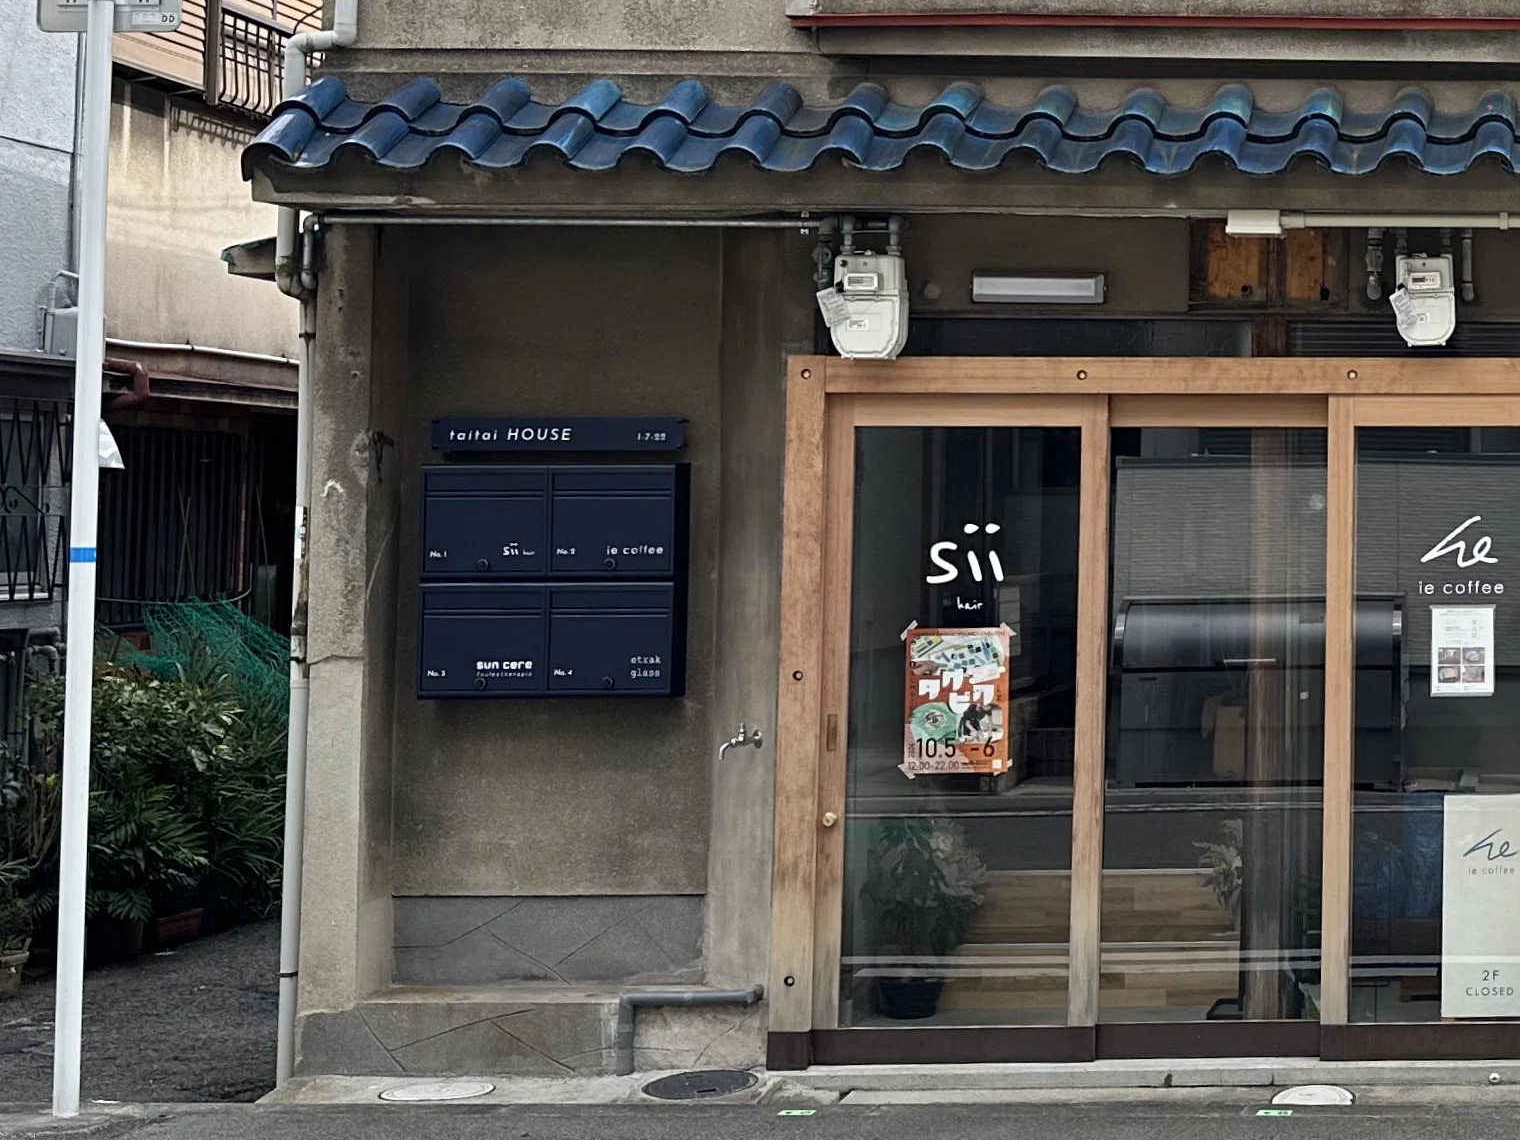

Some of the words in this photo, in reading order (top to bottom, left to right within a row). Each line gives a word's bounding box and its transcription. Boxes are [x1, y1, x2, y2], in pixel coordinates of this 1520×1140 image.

[449, 429, 498, 441] taitai
[507, 427, 572, 441] HOUSE
[622, 545, 664, 555] coffee
[1418, 580, 1435, 595] ie
[1442, 580, 1505, 595] coffee
[630, 655, 661, 664] etrak
[476, 661, 500, 670] sun
[502, 661, 533, 670] cere
[916, 738, 956, 758] 10.5
[1482, 866, 1515, 875] coffee
[1482, 969, 1500, 982] 2F
[1465, 986, 1515, 997] CLOSED
